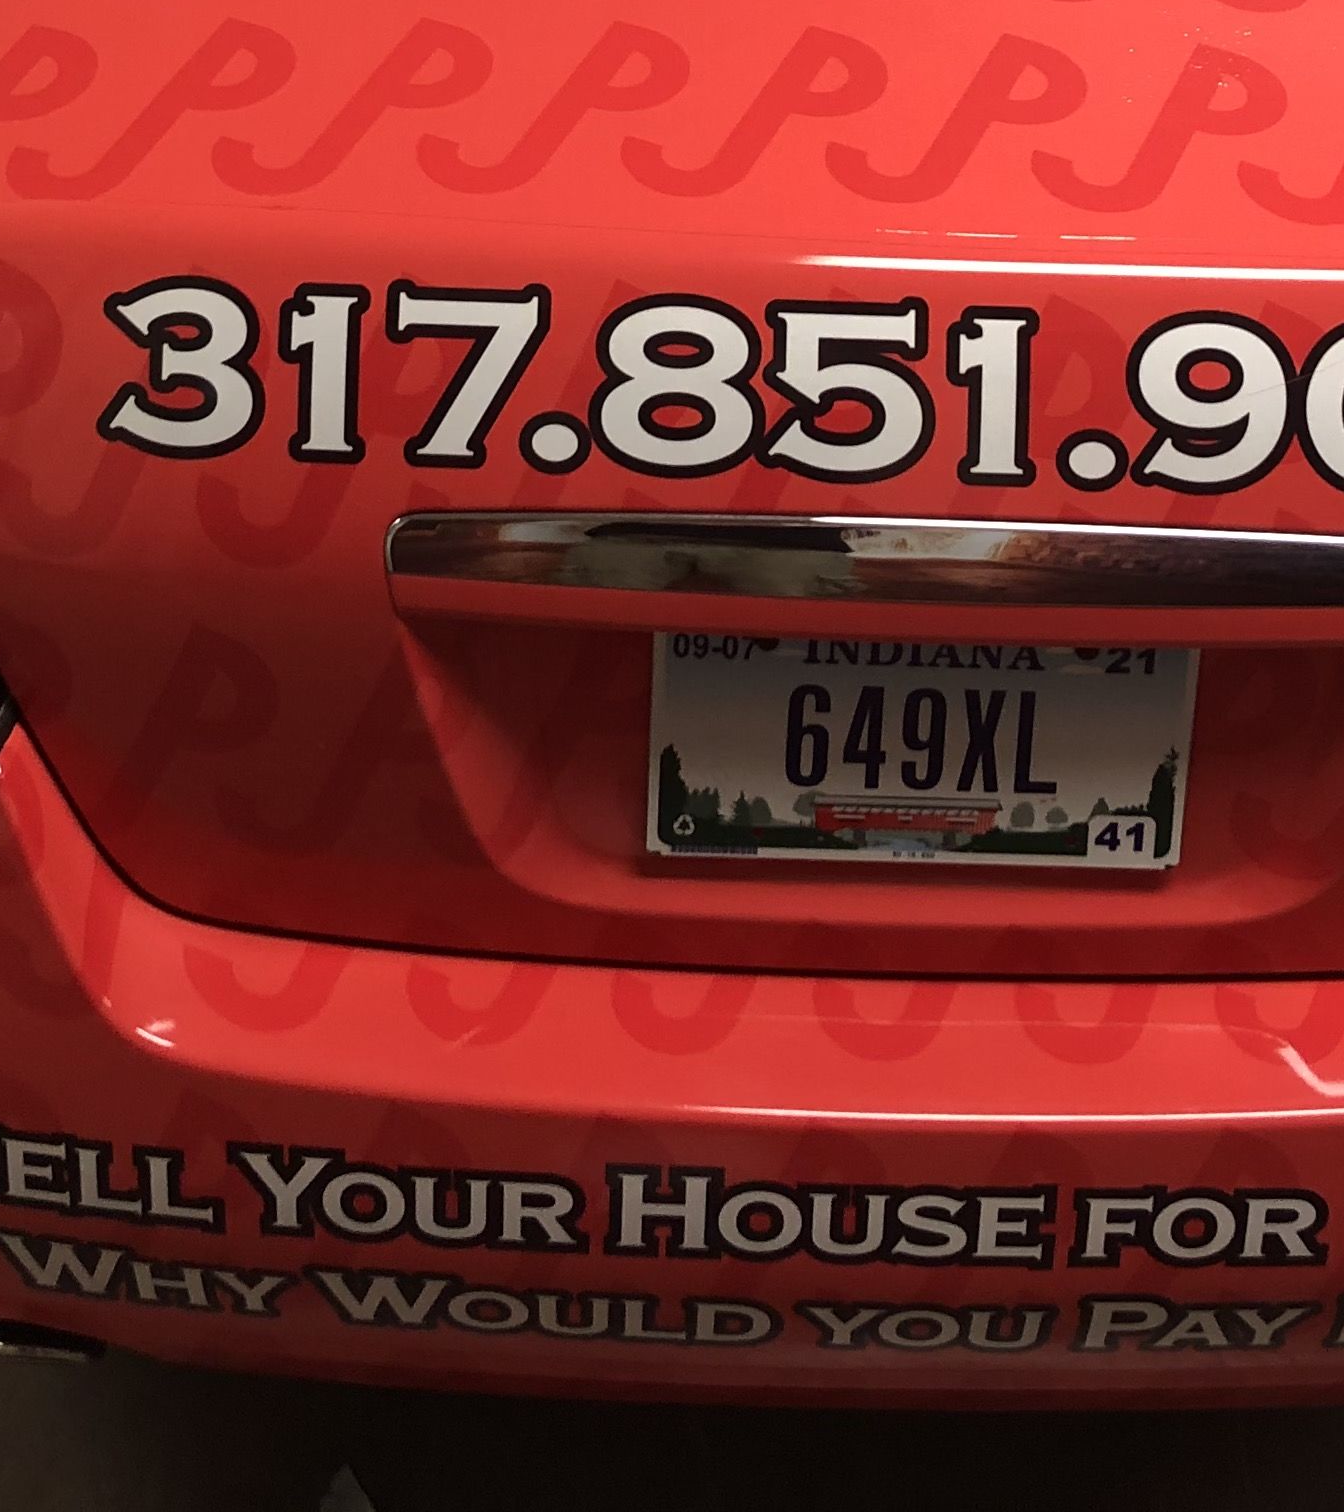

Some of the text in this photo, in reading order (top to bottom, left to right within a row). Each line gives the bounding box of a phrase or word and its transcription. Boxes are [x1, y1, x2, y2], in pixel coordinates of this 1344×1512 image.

[803, 636, 1045, 672] INDIANA
[1104, 645, 1156, 675] 21
[785, 684, 1058, 794] 649XL
[1094, 821, 1146, 852] 41
[227, 1141, 589, 1253] YOUR
[603, 1164, 1051, 1267] HOUSE
[1068, 1185, 1329, 1267] FOR
[305, 1264, 786, 1348] WOULD
[794, 1301, 1049, 1353] YOU
[1064, 1292, 1329, 1353] PAY
